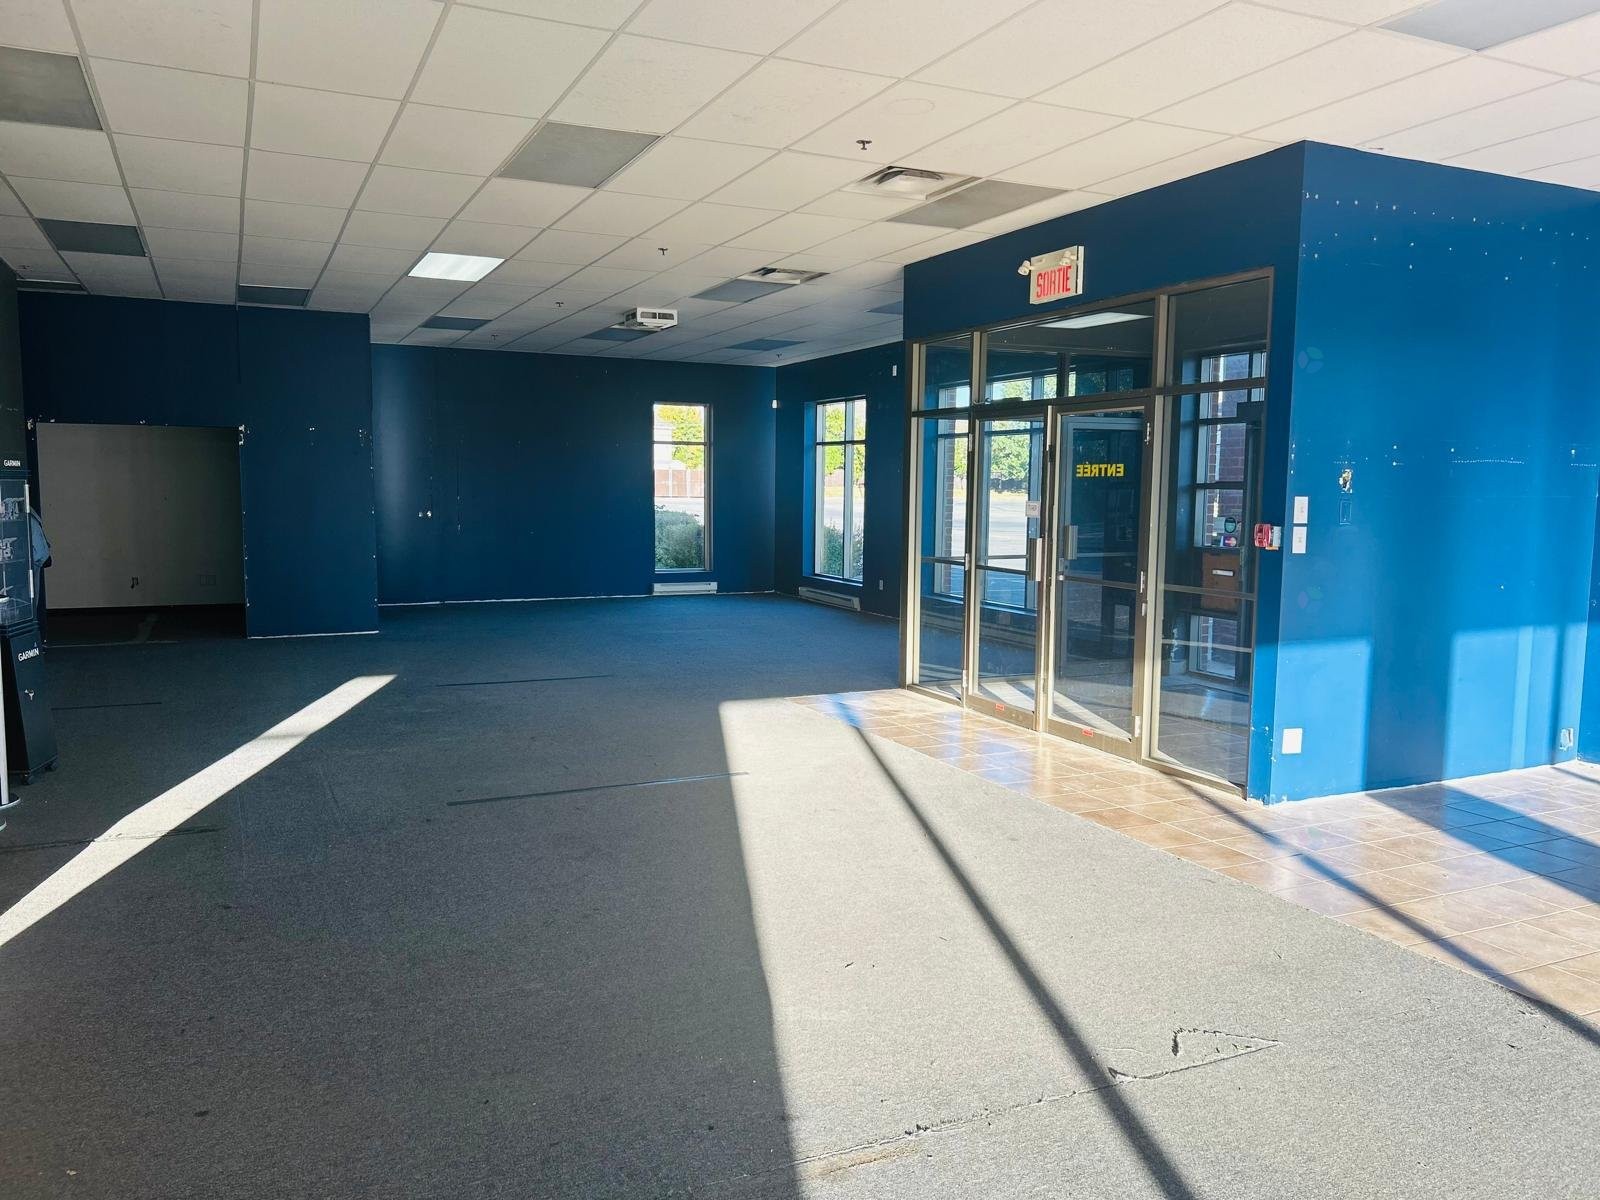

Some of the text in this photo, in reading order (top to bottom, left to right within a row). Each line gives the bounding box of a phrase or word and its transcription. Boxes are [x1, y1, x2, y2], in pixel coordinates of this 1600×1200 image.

[1036, 265, 1072, 298] SORTIE
[3, 459, 21, 467] GARMIN
[17, 647, 40, 661] GARMIN
